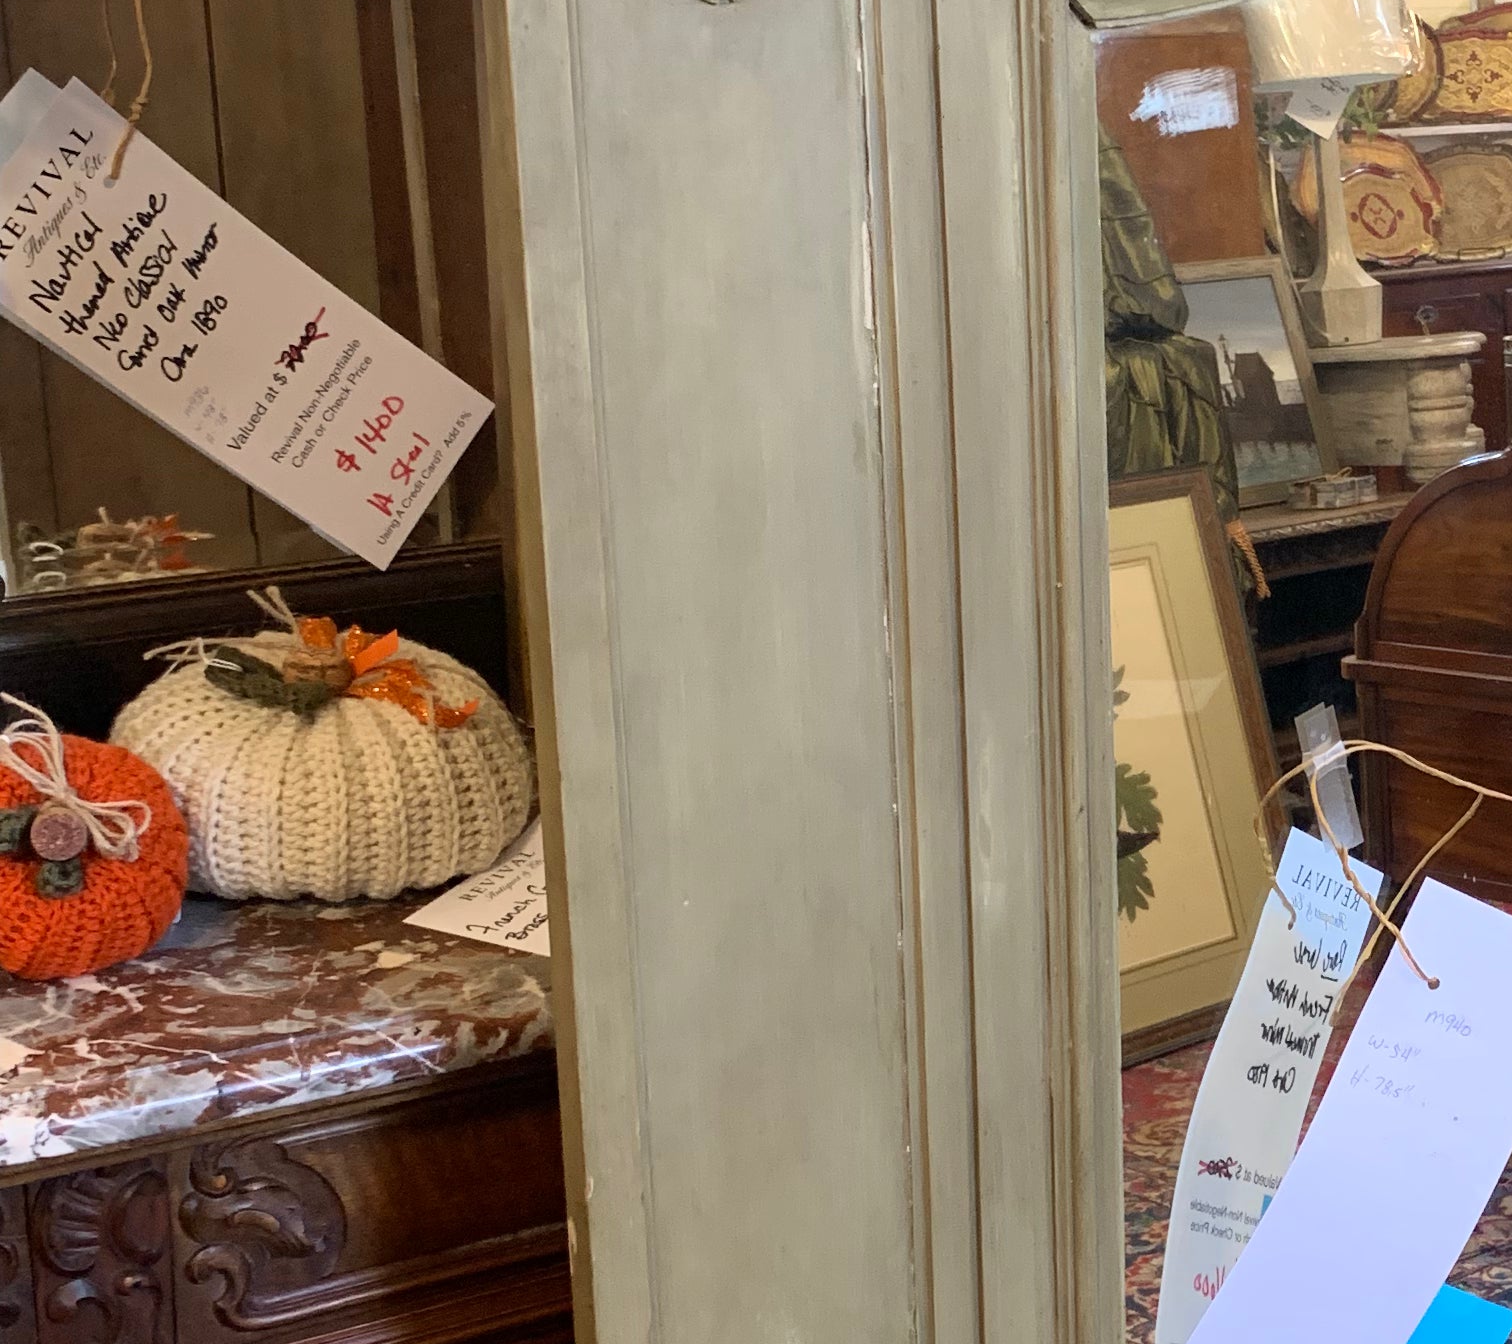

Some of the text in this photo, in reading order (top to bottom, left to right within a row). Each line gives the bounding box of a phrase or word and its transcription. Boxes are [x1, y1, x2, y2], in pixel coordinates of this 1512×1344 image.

[226, 401, 268, 452] Valued
[264, 385, 281, 404] at
[273, 372, 288, 387] $
[271, 338, 362, 464] Revival Non-Negotiable
[291, 356, 373, 469] Cash or Check Price
[334, 396, 405, 472] $ 1400
[376, 517, 401, 546] Using
[395, 507, 406, 519] A
[401, 476, 426, 509] Credit
[443, 427, 460, 448] Add
[456, 410, 474, 428] 5%
